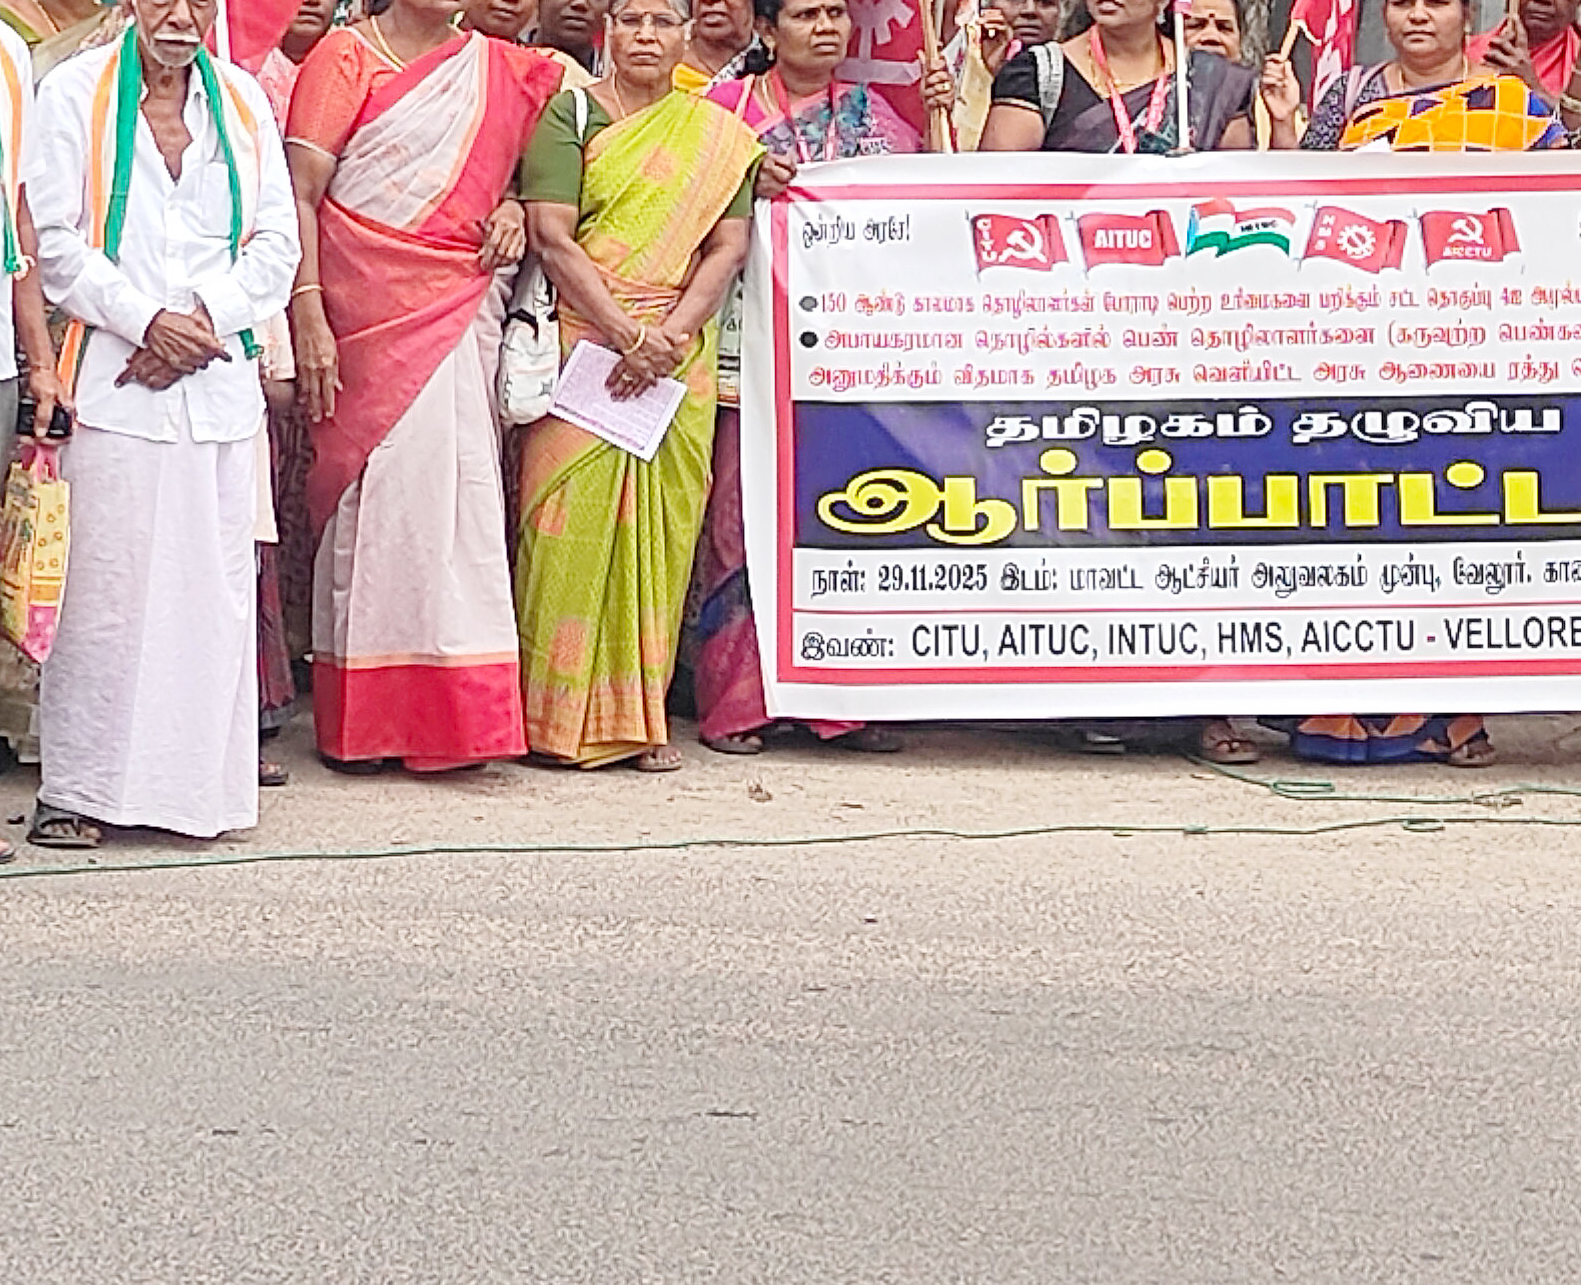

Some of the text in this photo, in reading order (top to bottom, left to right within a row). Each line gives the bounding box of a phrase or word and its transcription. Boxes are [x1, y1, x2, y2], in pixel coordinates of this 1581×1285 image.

[863, 214, 911, 246] அரசே!
[1094, 227, 1153, 250] AITUC
[1122, 323, 1179, 349] பெண்
[954, 363, 1035, 389] விதமாக
[1046, 360, 1117, 391] தமிழக
[1129, 364, 1181, 388] அரசு
[1313, 361, 1366, 384] அரசு
[1507, 353, 1561, 383] ரத்து
[985, 400, 1562, 448] தமிழகம் தழுவிய
[810, 559, 866, 599] நாள்:
[877, 563, 988, 592] 29.11.2025
[1000, 559, 1057, 592] இடம்:
[1070, 564, 1144, 591] மாவட்ட
[801, 627, 895, 662] இவண்:
[912, 624, 990, 662] CITU,
[998, 624, 1098, 660] AITUC,
[1108, 622, 1208, 660] INTUC,
[1217, 621, 1292, 658] HMS,
[1301, 620, 1416, 653] AICCTU
